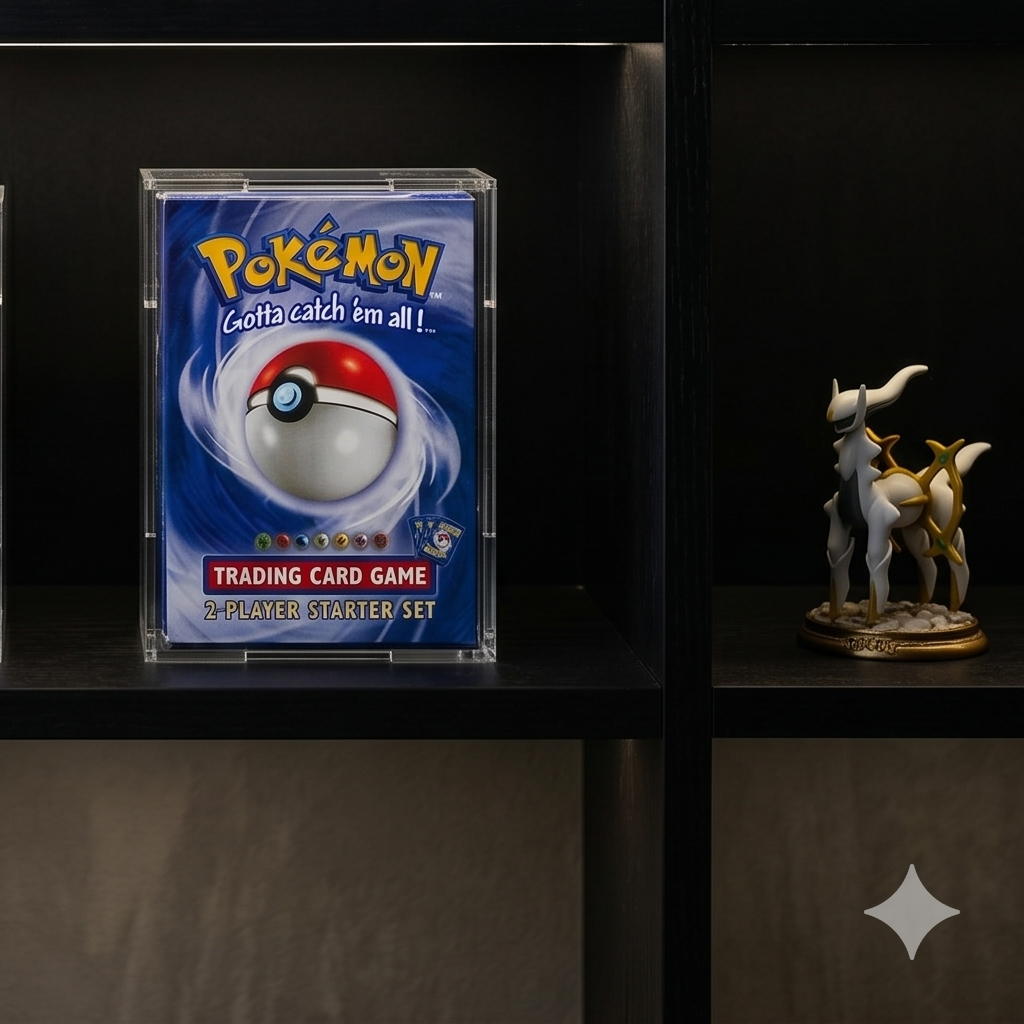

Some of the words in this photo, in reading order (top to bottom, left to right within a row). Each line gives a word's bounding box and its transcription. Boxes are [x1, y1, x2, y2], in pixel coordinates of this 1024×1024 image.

[223, 302, 284, 334] Gotta
[290, 292, 345, 322] catch
[352, 297, 383, 325] 'em
[213, 566, 302, 585] TRADING
[309, 566, 363, 585] CARD
[370, 566, 427, 585] GAME
[204, 600, 300, 621] 2-PLAYER
[308, 600, 394, 621] STARTER
[401, 600, 437, 621] SET
